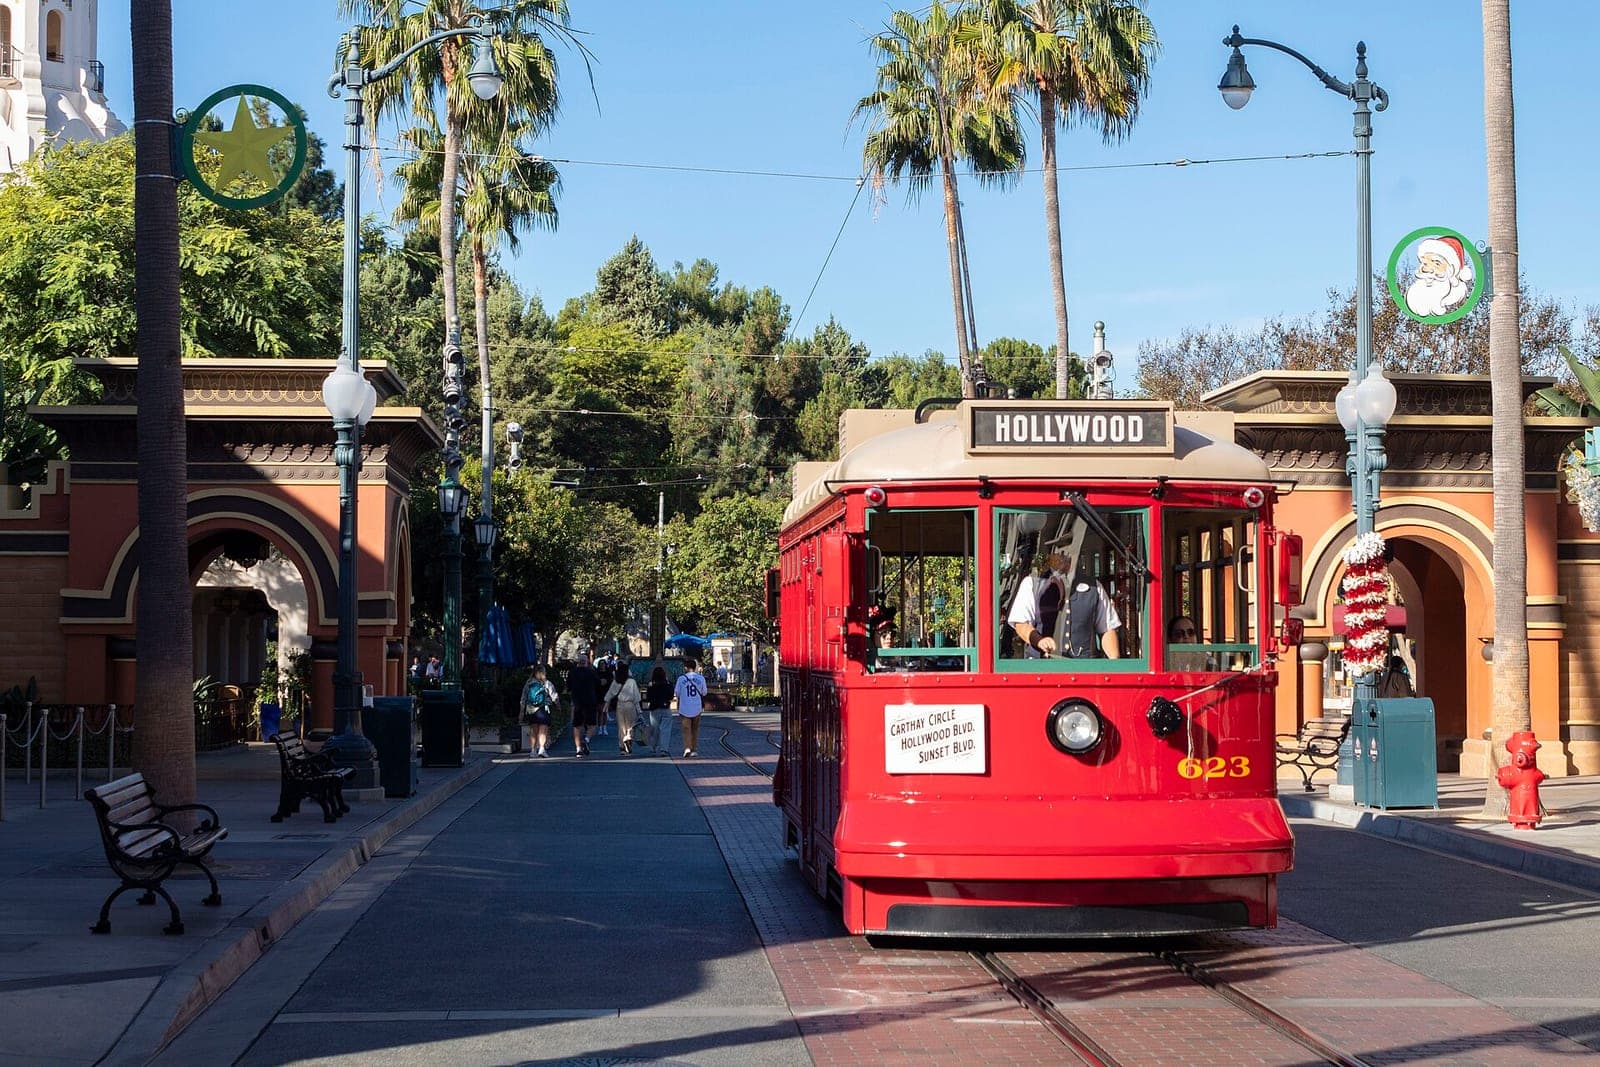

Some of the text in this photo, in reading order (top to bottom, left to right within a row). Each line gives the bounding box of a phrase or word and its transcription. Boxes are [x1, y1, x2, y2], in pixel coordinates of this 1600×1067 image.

[995, 414, 1144, 443] HOLLYWOOD
[686, 685, 697, 697] 18
[890, 709, 956, 736] CARTHAY CIRCLE
[901, 722, 975, 750] HOLLYWOOD BLVD.
[919, 739, 976, 763] SUNSET BLVD.
[1177, 756, 1251, 779] 623
